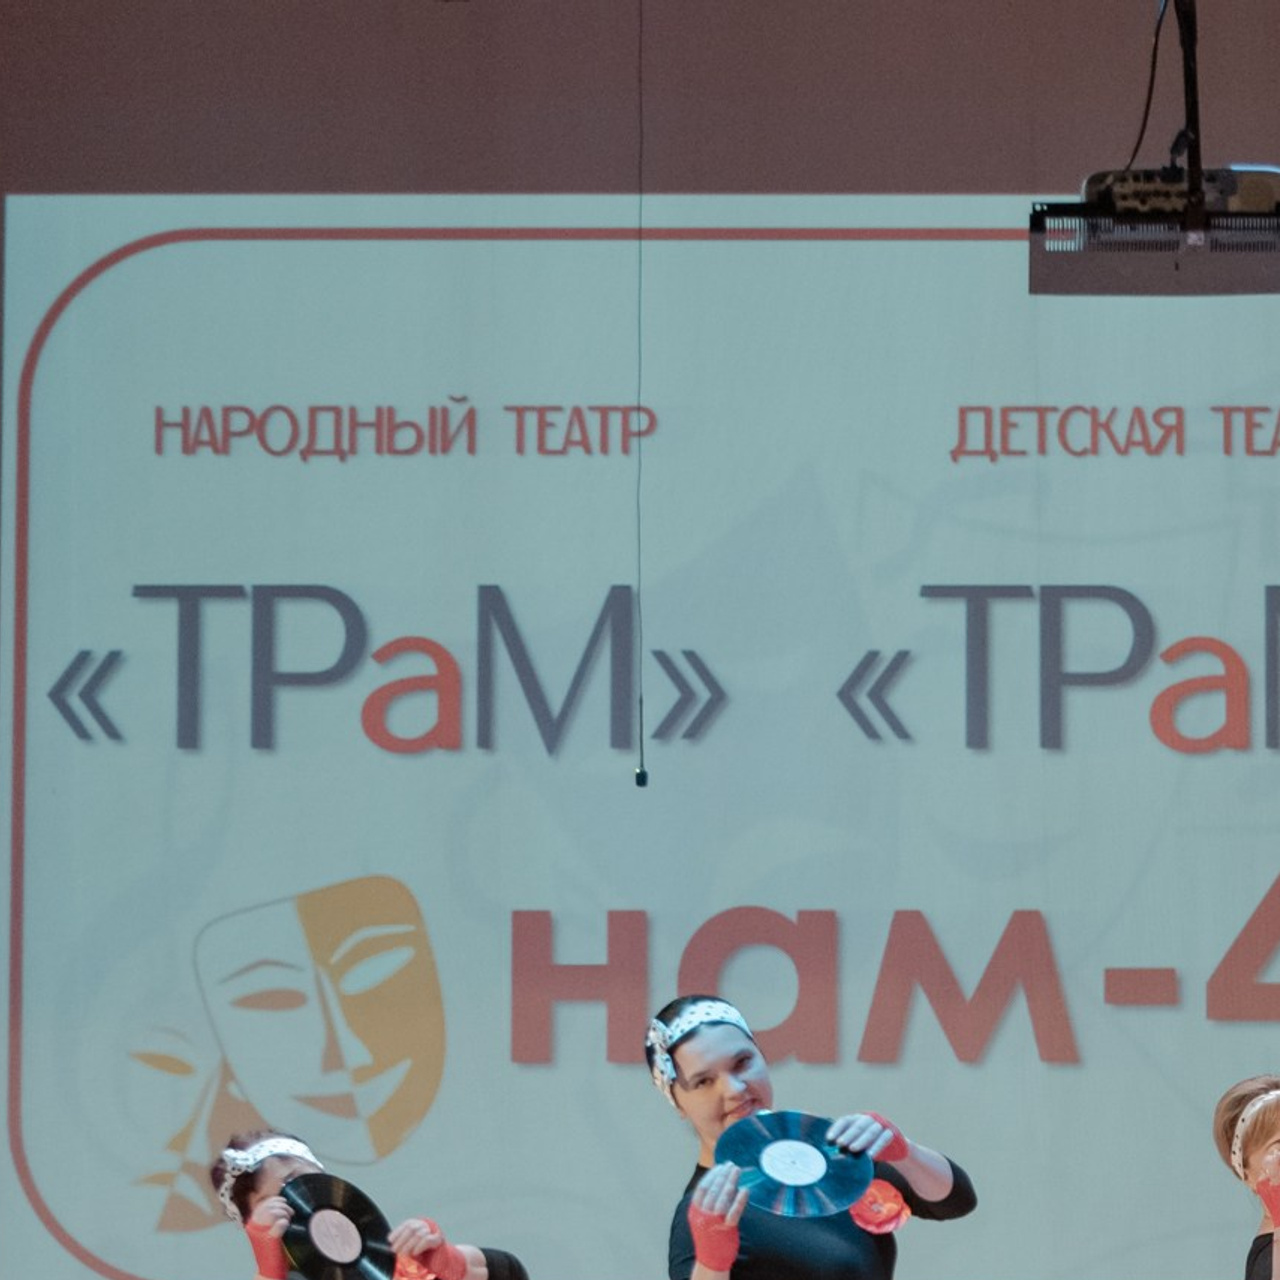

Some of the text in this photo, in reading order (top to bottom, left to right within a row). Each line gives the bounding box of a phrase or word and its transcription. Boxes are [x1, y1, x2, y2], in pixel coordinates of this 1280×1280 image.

[154, 395, 658, 463] НАРОДНЫЙ ТЕАТР
[949, 404, 1186, 463] ДЕТСКАЯ
[46, 583, 726, 757] «ТРаМ»
